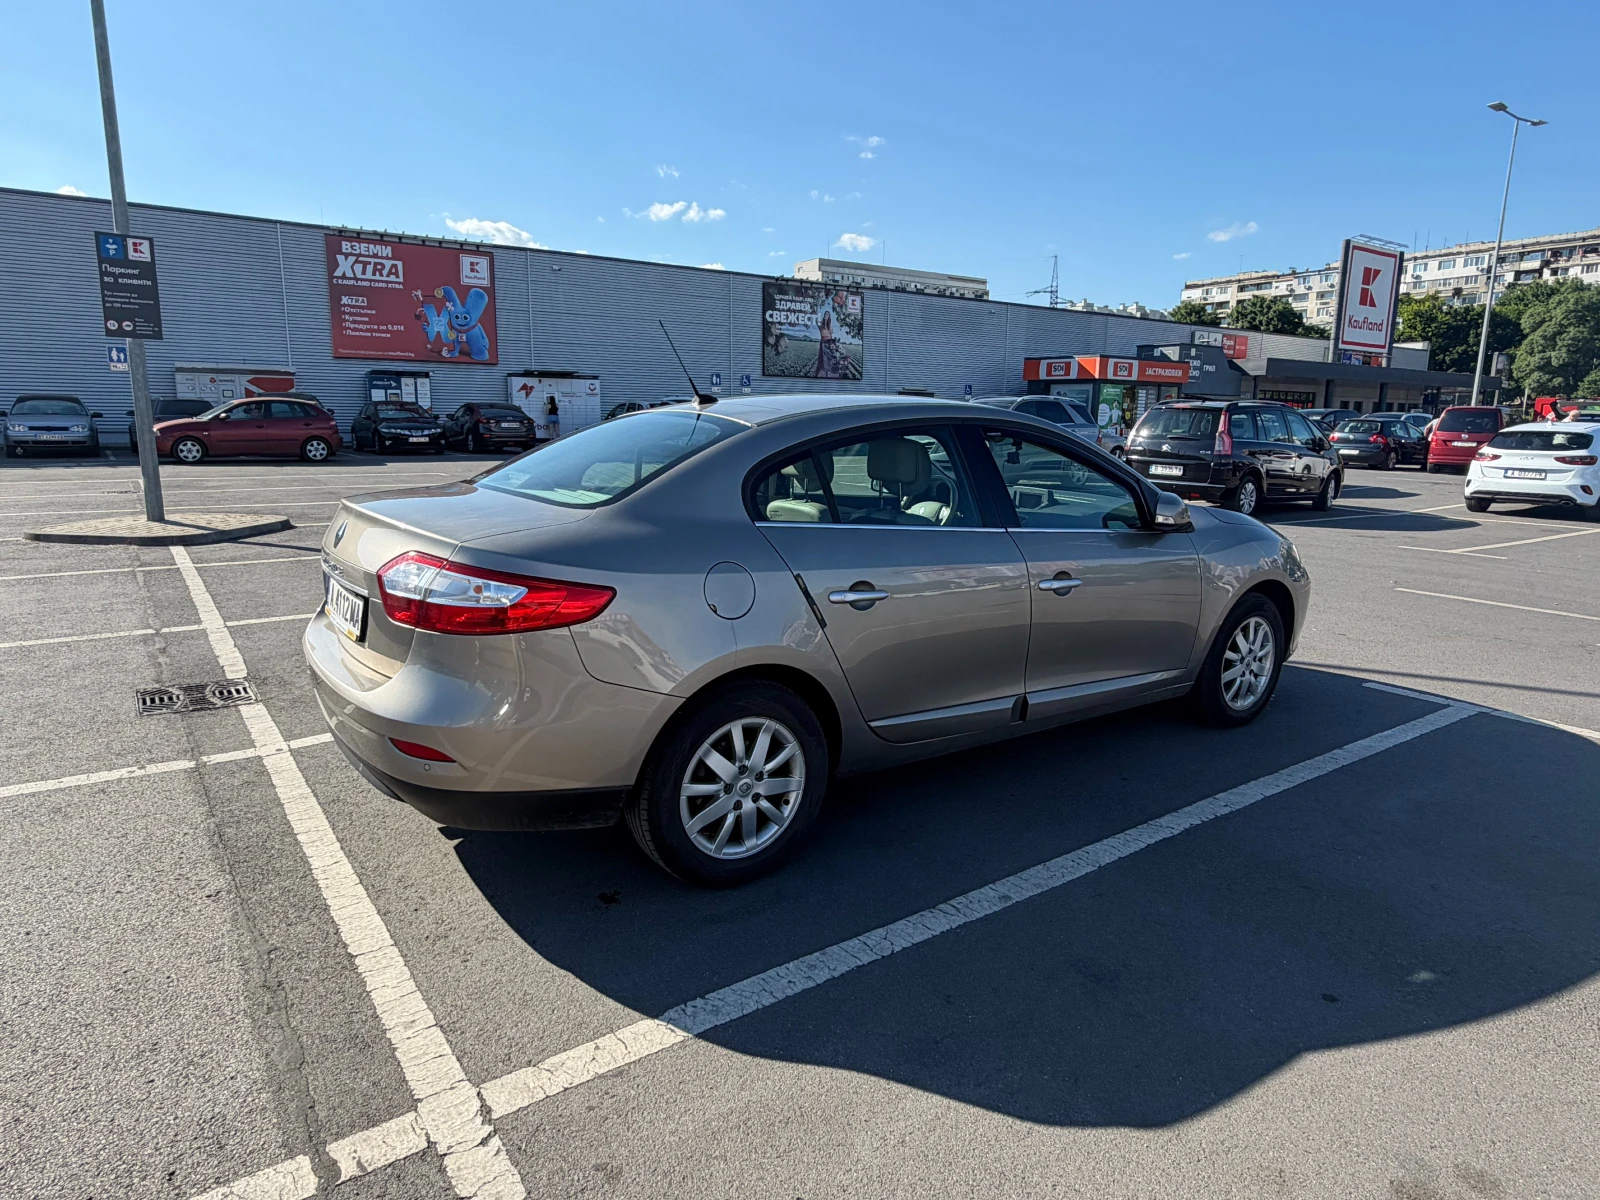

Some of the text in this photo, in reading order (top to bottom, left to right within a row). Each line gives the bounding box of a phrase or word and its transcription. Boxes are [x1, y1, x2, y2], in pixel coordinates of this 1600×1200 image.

[341, 241, 392, 257] ВЗЕМИ
[102, 263, 140, 275] Паркинг
[333, 254, 403, 282] XTRA
[118, 278, 152, 286] клиенти
[338, 279, 370, 287] KAUFLAND
[340, 296, 367, 306] XTRA
[345, 306, 376, 314] Отстъпки
[775, 300, 811, 312] ЗДРАВЕЙ,
[765, 310, 822, 326] СВЕЖЕСТ!
[345, 322, 378, 331] Продукти
[1348, 314, 1384, 332] Kaufland
[1184, 359, 1201, 367] ЕЖО
[1053, 364, 1064, 372] SDI
[1118, 364, 1128, 373] SDI
[1145, 367, 1183, 377] ЗАСТРАХОВКИ
[1203, 364, 1216, 372] ГРИЛ
